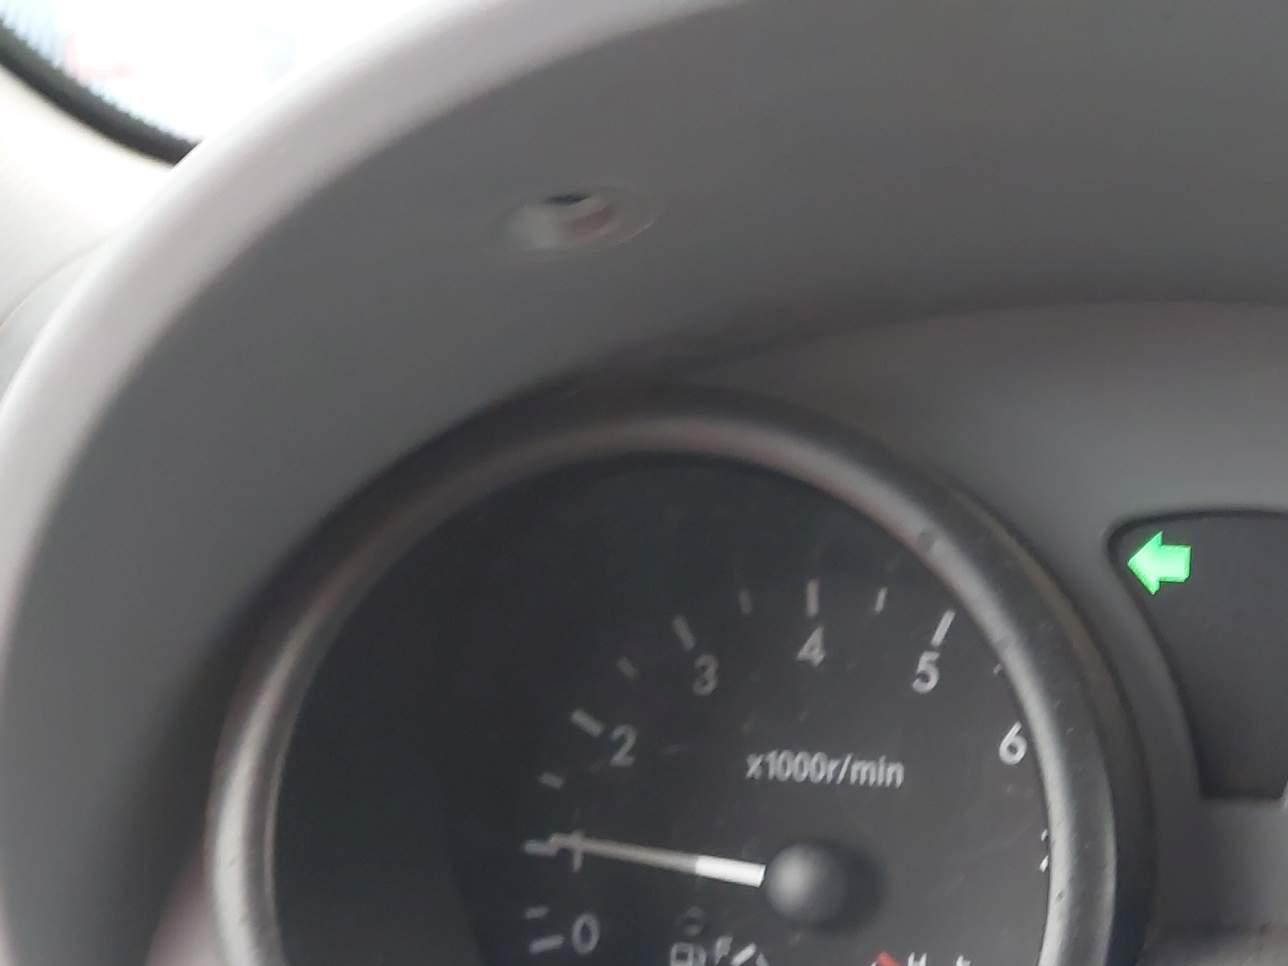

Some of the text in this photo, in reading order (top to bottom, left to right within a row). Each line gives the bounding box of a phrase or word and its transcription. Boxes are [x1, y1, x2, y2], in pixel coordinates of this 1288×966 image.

[797, 625, 826, 667] 4
[692, 654, 719, 696] 3
[912, 651, 940, 693] 5
[609, 726, 637, 768] 2
[998, 721, 1028, 766] 6
[746, 749, 905, 788] x1000r/min
[571, 913, 600, 955] 0
